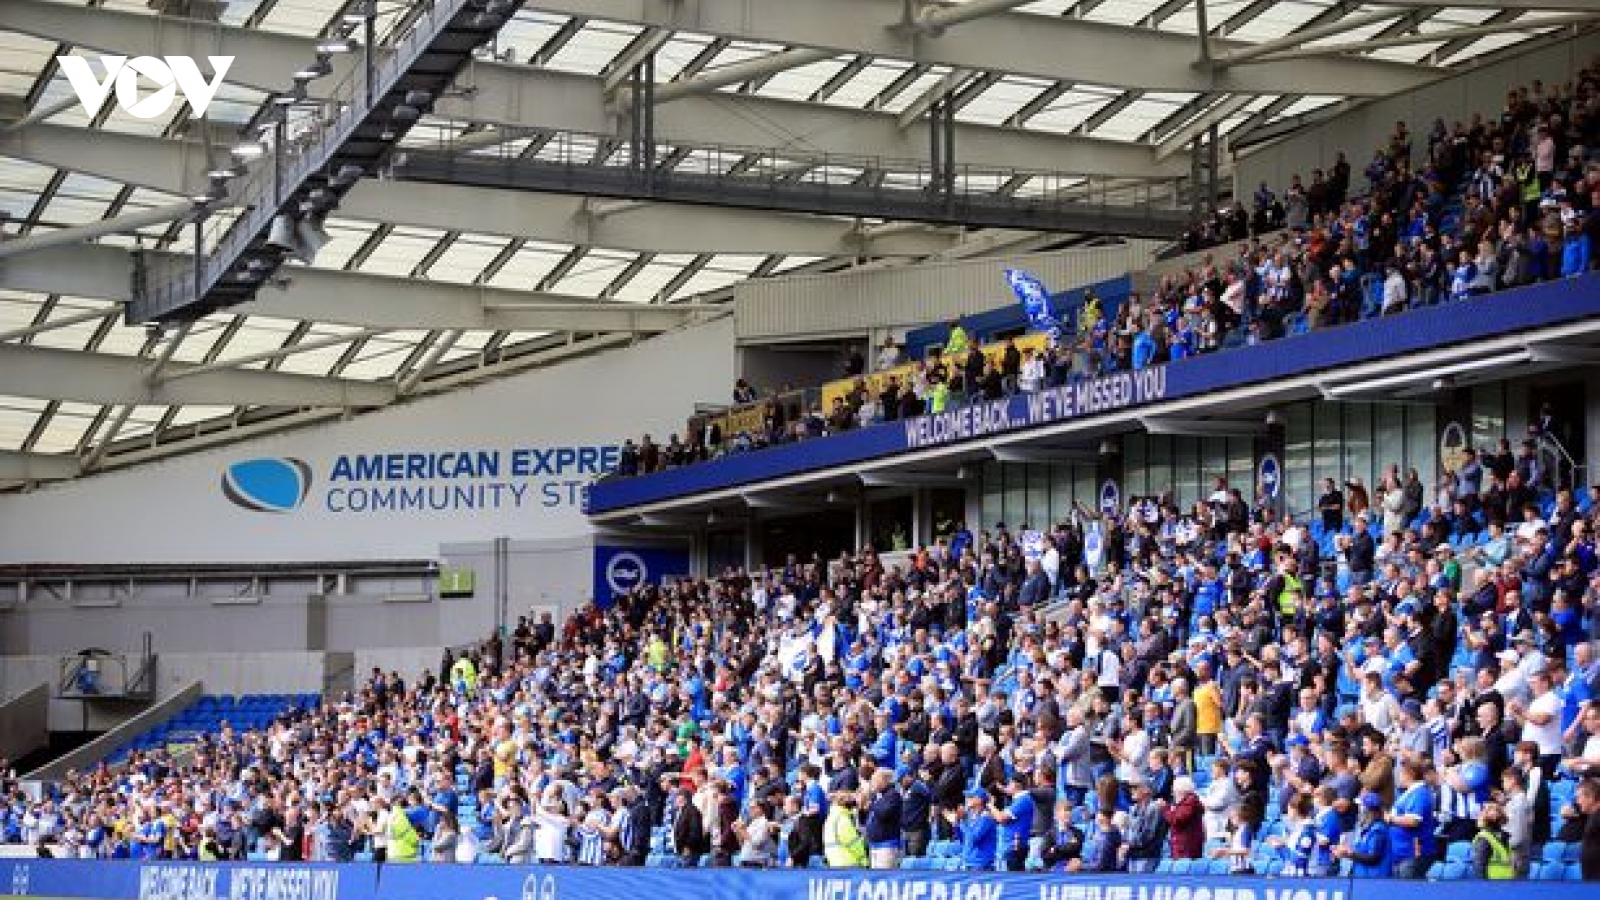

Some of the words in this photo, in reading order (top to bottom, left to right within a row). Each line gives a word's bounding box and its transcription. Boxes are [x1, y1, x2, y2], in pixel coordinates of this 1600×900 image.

[905, 408, 971, 448] WELCOME
[1076, 372, 1132, 414] MISSED
[1133, 364, 1167, 402] YOU
[330, 451, 500, 482] AMERICAN
[512, 446, 620, 476] EXPRE
[327, 482, 527, 513] COMMUNITY
[541, 480, 582, 508] ST
